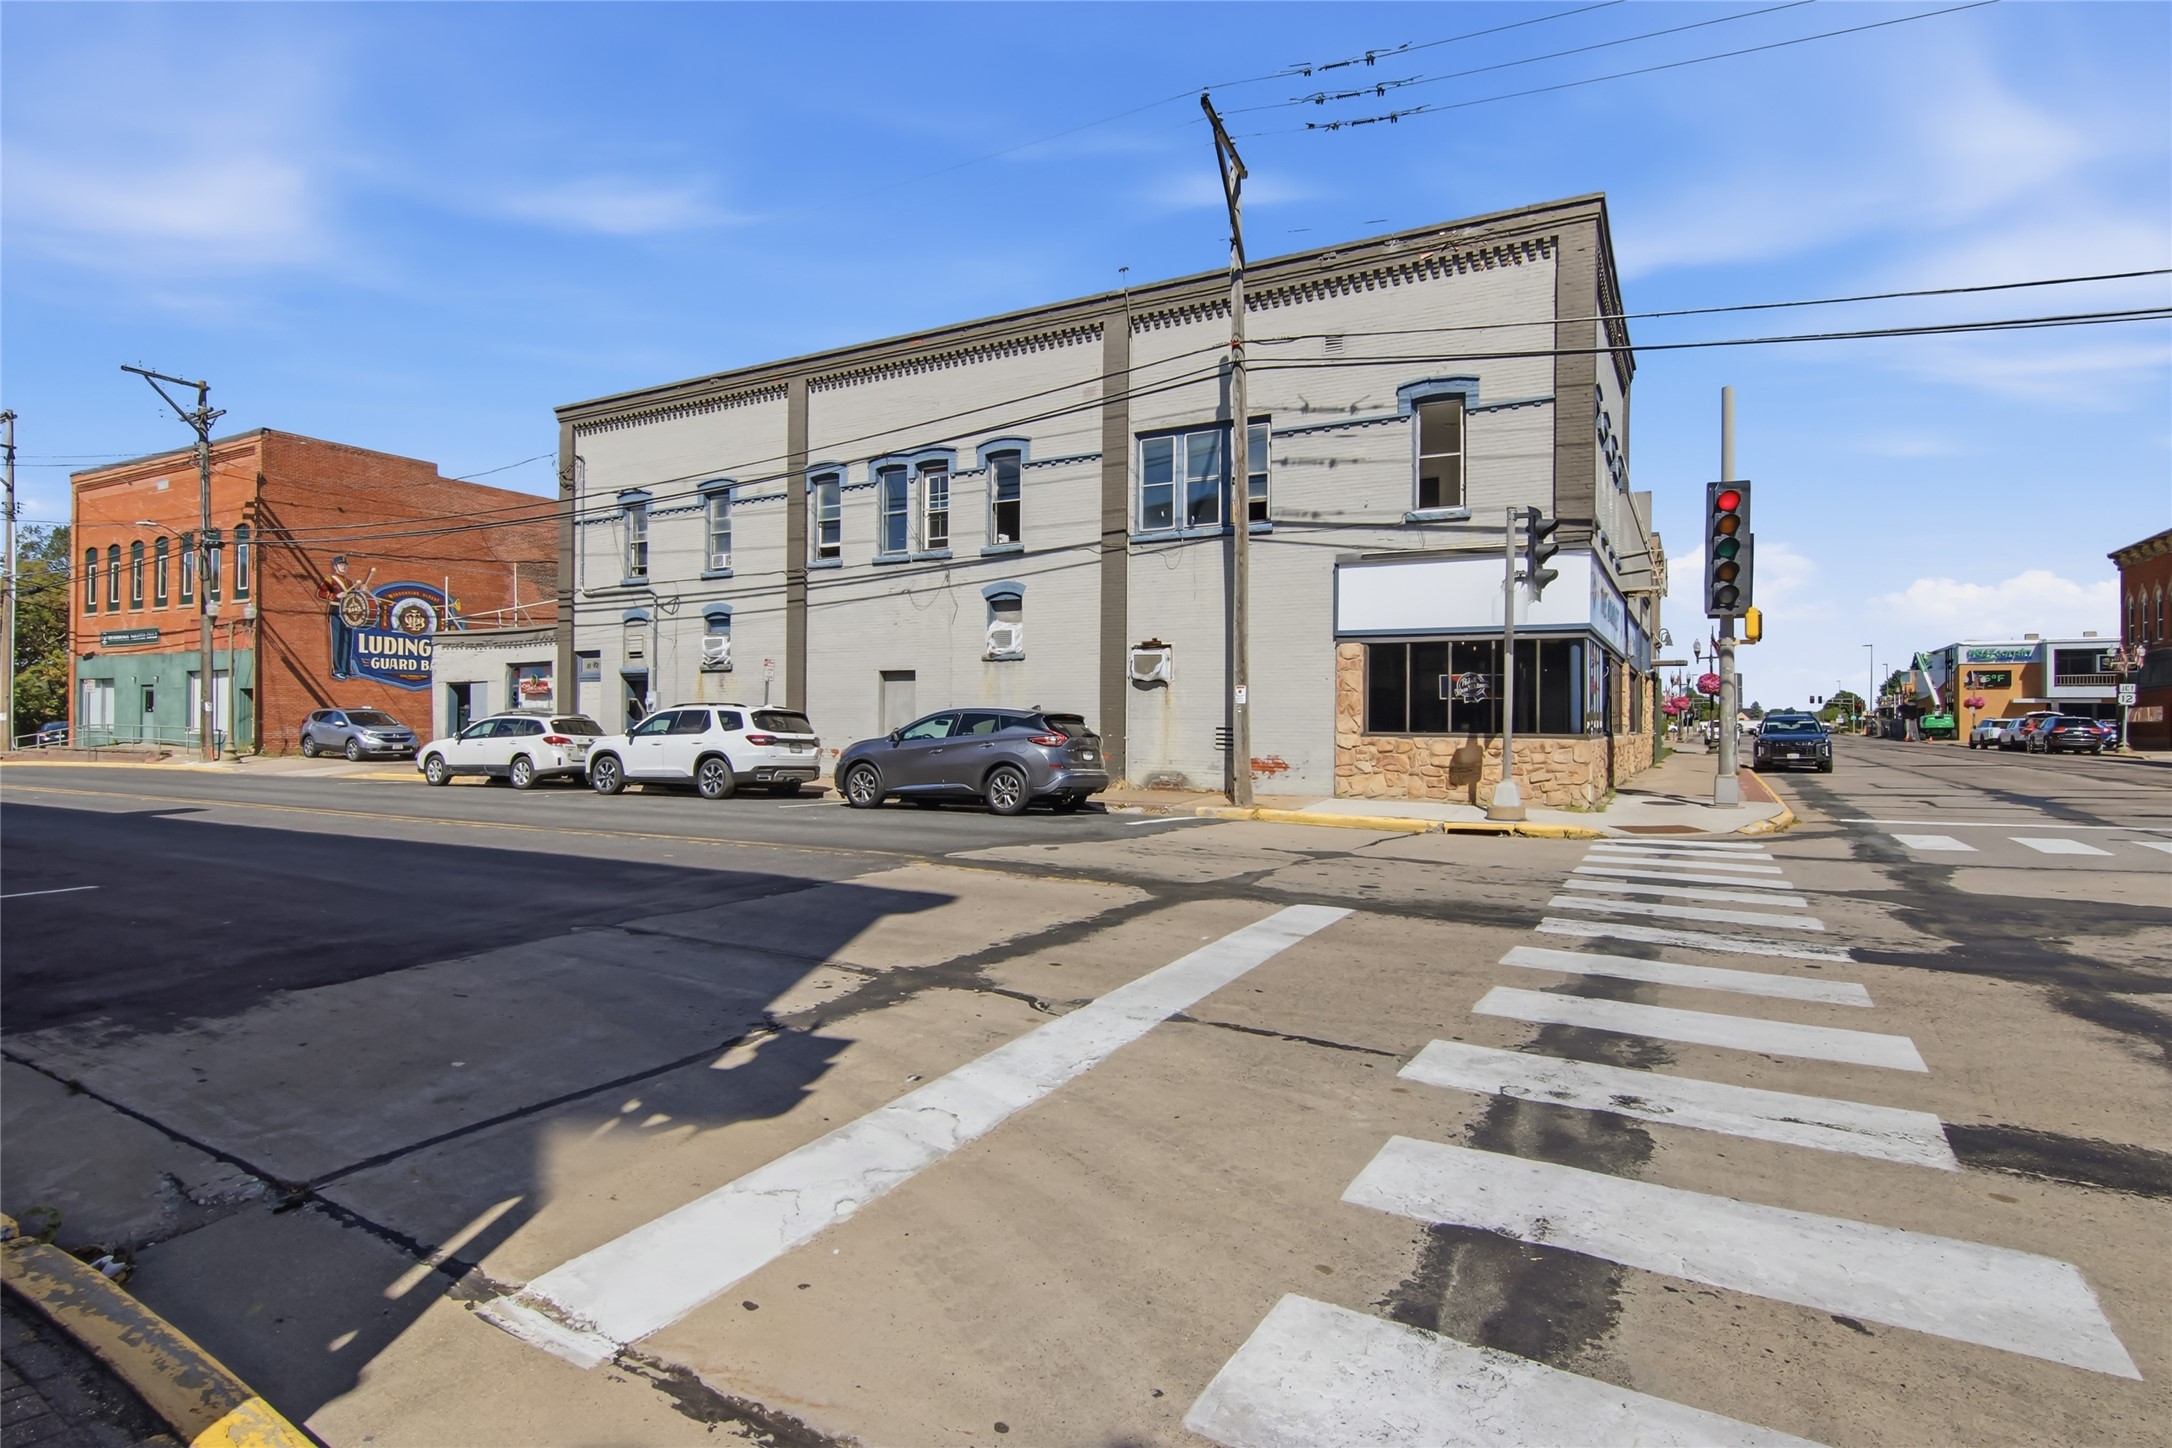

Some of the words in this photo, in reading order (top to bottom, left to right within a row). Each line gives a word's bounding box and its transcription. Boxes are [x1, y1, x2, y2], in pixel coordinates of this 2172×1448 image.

[371, 658, 417, 671] GUARD
[421, 662, 432, 672] B
[2121, 695, 2133, 703] 12
